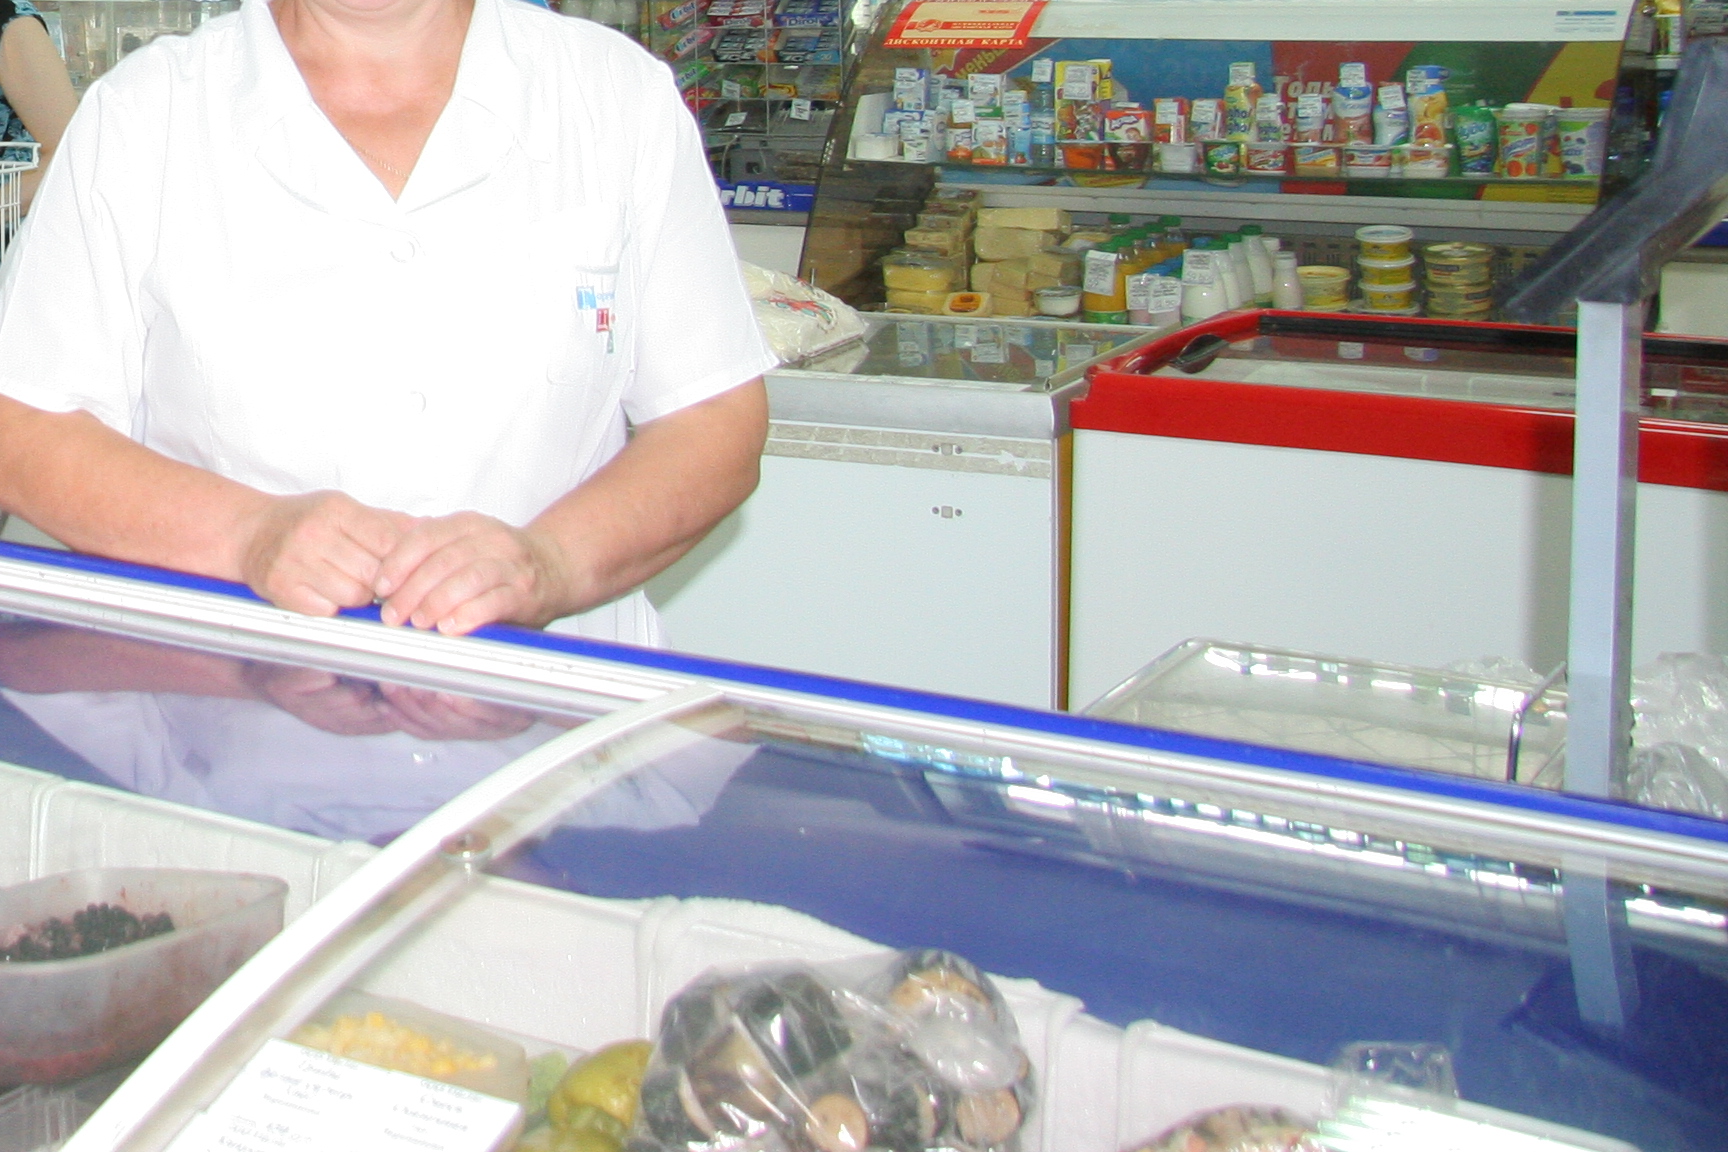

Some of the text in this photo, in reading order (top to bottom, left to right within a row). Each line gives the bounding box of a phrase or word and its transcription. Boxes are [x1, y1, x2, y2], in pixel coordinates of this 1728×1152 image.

[884, 38, 1024, 46] ДИСКОНТНАЯ КАРТА
[718, 185, 784, 208] rbit
